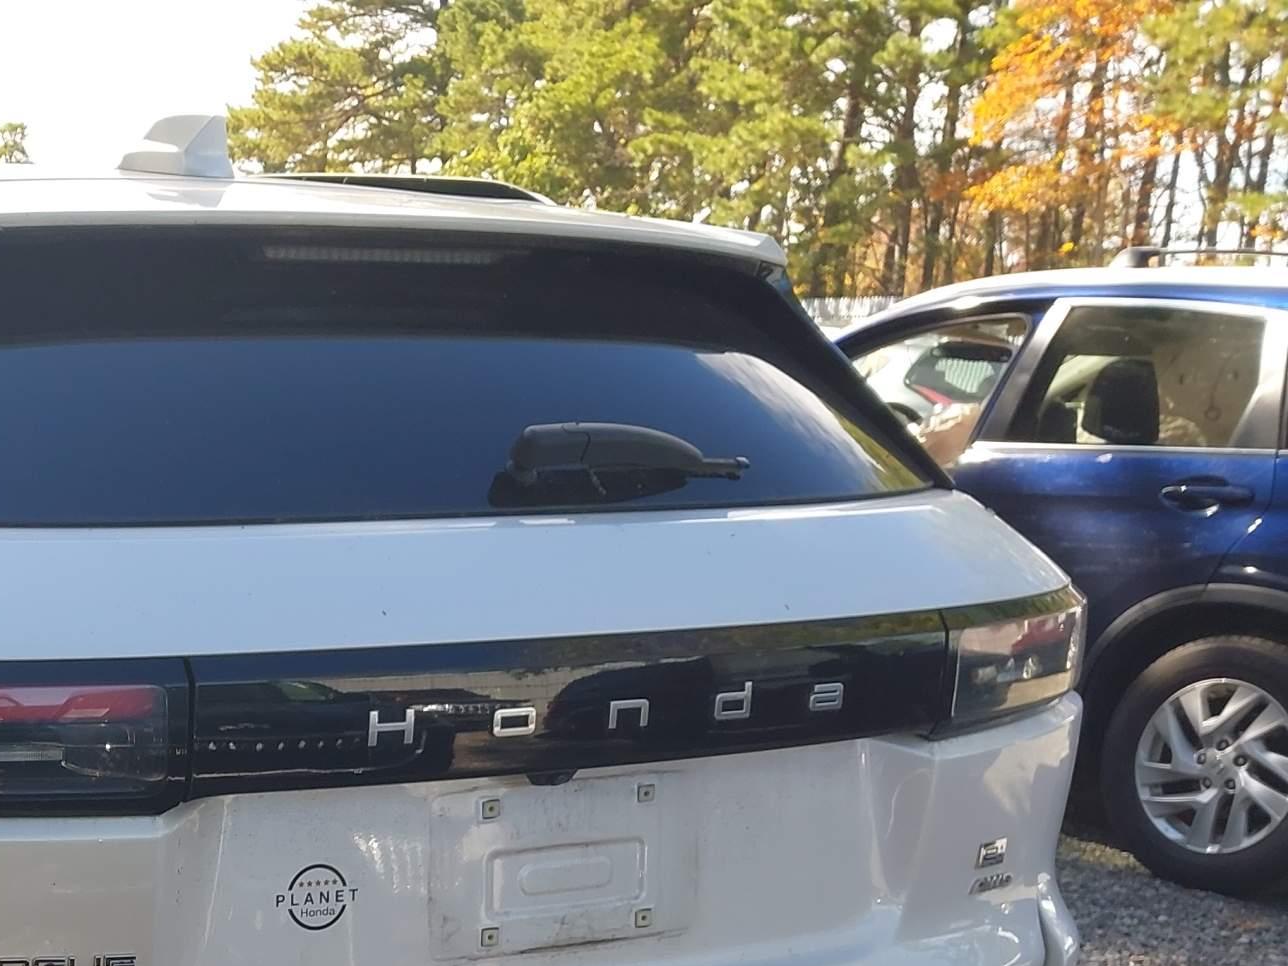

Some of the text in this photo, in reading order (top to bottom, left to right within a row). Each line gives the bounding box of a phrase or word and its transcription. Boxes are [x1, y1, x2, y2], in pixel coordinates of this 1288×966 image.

[367, 681, 845, 747] Honda
[275, 888, 359, 908] PLANET
[300, 906, 336, 918] Honda
